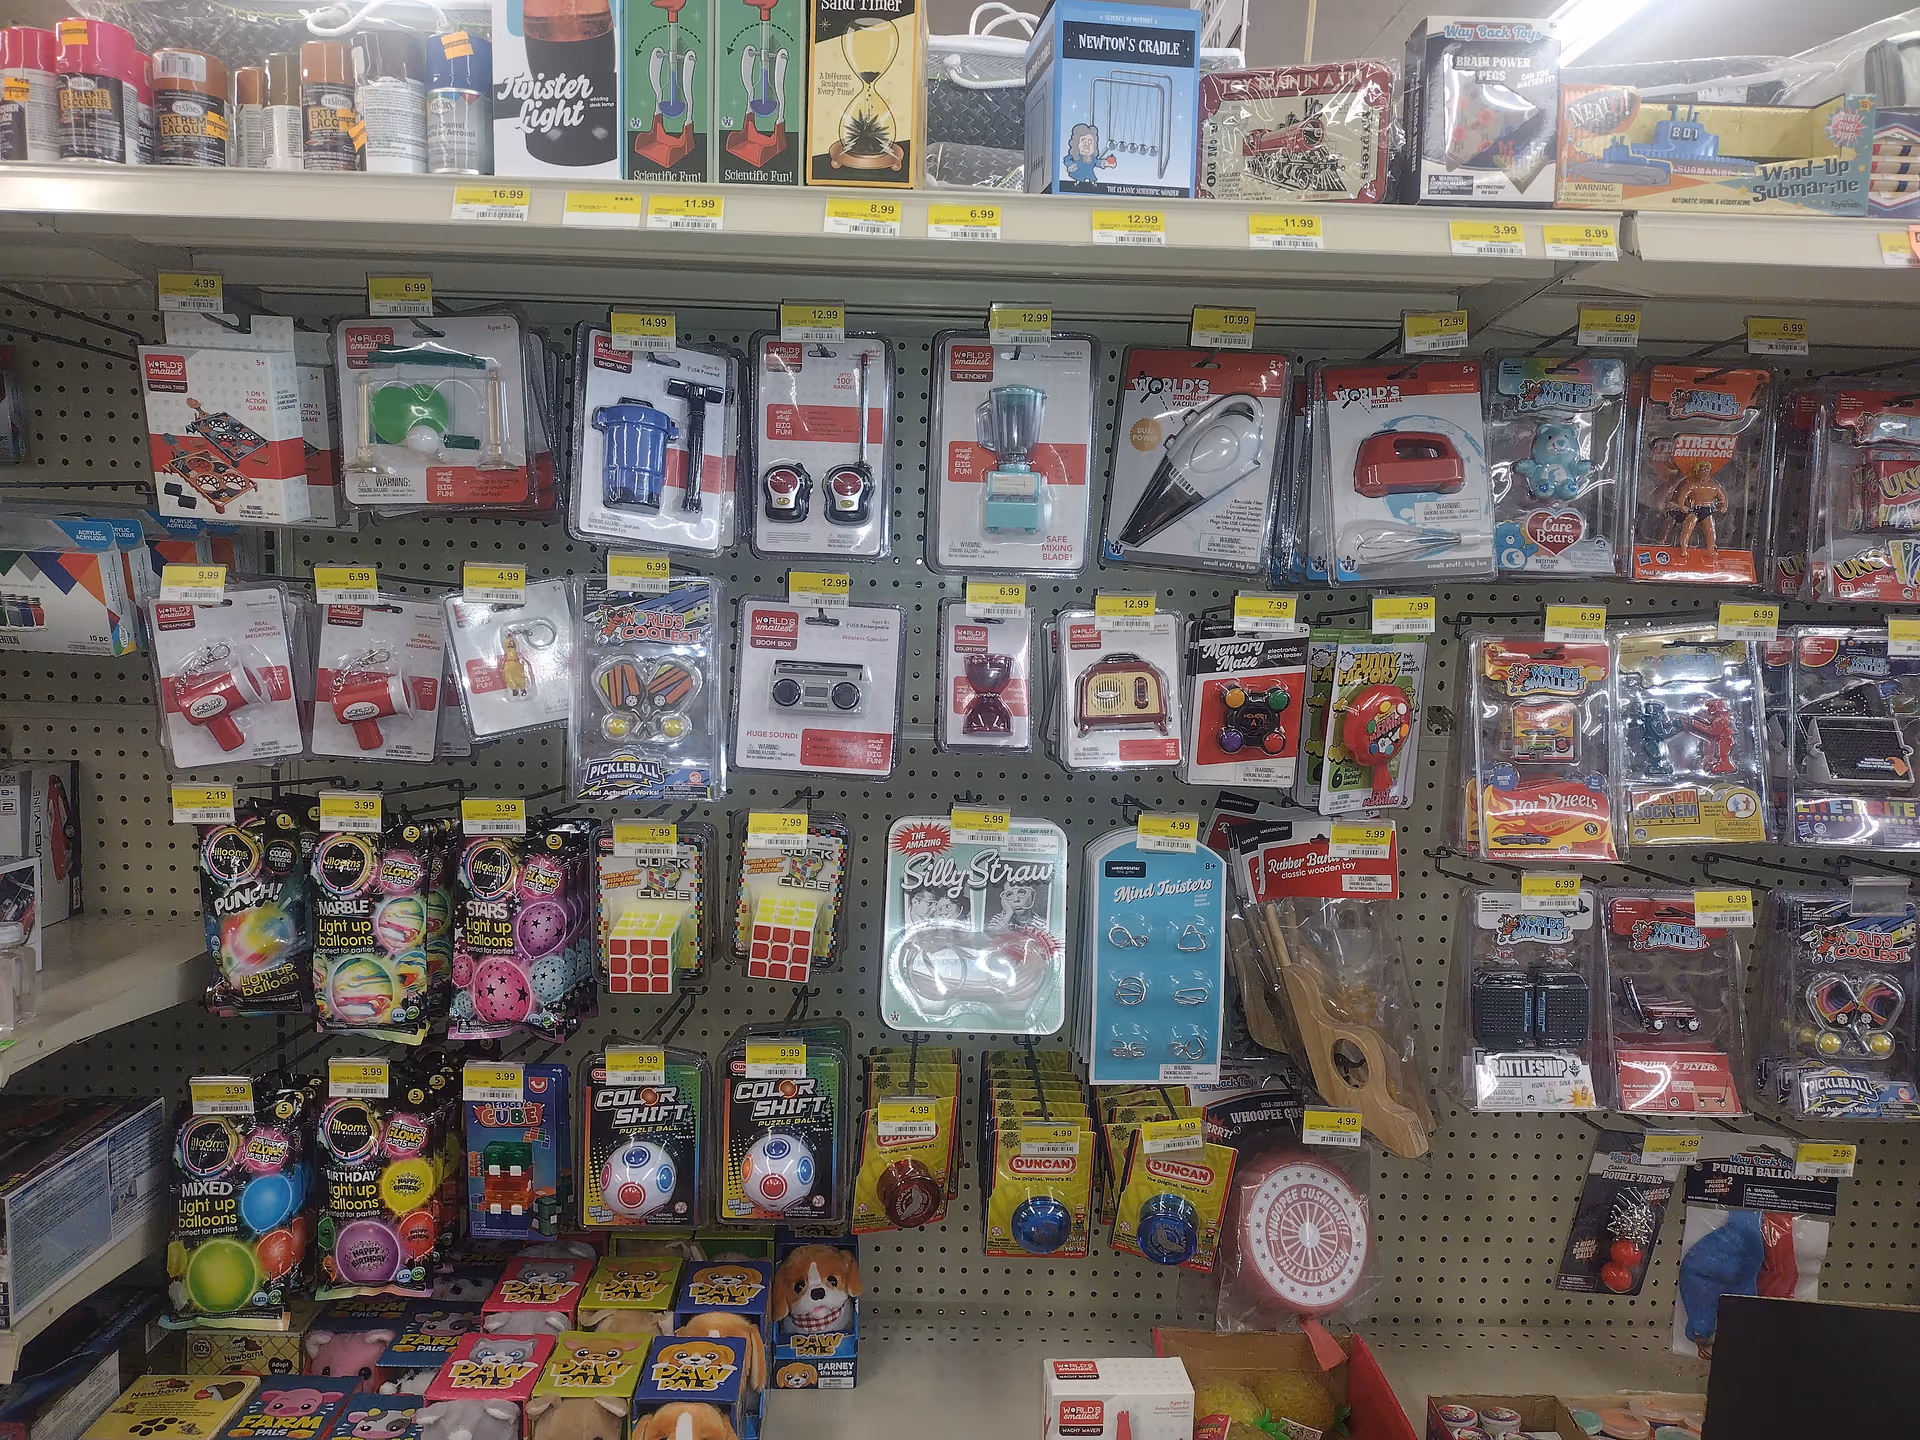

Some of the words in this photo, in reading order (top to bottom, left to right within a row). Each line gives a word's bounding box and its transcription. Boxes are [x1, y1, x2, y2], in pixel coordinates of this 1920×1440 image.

[822, 0, 855, 11] Sand
[860, 0, 902, 11] Timer
[1444, 24, 1475, 40] Way
[1477, 26, 1508, 39] Back
[1513, 24, 1542, 40] Toys
[1079, 34, 1135, 54] NEWTON'S
[1138, 38, 1180, 56] CRADLE
[1457, 56, 1491, 67] BRAIN
[1493, 57, 1530, 68] POWER
[828, 72, 852, 81] Different
[1479, 70, 1506, 81] PEGS
[497, 72, 592, 102] Twister
[820, 81, 849, 90] Sculpture
[62, 91, 106, 101] EXTREME
[818, 88, 835, 97] Every
[837, 87, 854, 96] Time!
[62, 99, 108, 110] LACQUER
[515, 101, 583, 135] Light
[1672, 127, 1699, 140] 801
[725, 170, 770, 182] Scientific
[771, 170, 792, 182] Fun!
[1760, 159, 1849, 183] Wind-Up
[1107, 186, 1117, 194] THE
[1118, 187, 1136, 195] CLASSIC
[1574, 183, 1616, 192] WARNING:
[1752, 180, 1859, 203] Submarine
[491, 188, 524, 202] 16.99
[683, 198, 716, 211] 11.99
[869, 203, 896, 216] 8.99
[970, 209, 995, 222] 6.99
[1126, 214, 1159, 226] 12.99
[1283, 217, 1314, 230] 11.99
[1493, 225, 1518, 236] 3.99
[1584, 229, 1609, 240] 8.99
[193, 278, 216, 290] 4.99
[403, 282, 427, 294] 6.99
[811, 309, 839, 321] 12.99
[1021, 312, 1049, 325] 12.99
[1223, 314, 1250, 327] 10.99
[1614, 313, 1637, 325] 6.99
[639, 316, 668, 329] 14.99
[1438, 318, 1465, 330] 12.99
[1782, 323, 1805, 334] 6.99
[349, 335, 391, 348] WORLD'S
[954, 351, 991, 361] WORLD'S
[955, 358, 990, 366] smallest
[148, 360, 184, 371] WORLD'S
[1270, 360, 1282, 370] 5+
[1463, 366, 1474, 374] 5+
[1132, 378, 1210, 396] WORLD'S
[1172, 393, 1209, 401] smallest
[1334, 385, 1400, 402] WORLD'S
[1370, 396, 1402, 404] smallest
[775, 422, 792, 430] BIG
[1677, 437, 1736, 450] STRETCH
[1674, 448, 1733, 459] ARMSTRONG
[376, 477, 411, 488] WARNING:
[1542, 520, 1573, 534] Care
[1537, 532, 1575, 545] Bears
[1040, 544, 1073, 553] MIXING
[1041, 552, 1073, 561] BLADE!
[646, 562, 668, 574] 6.99
[1465, 561, 1475, 569] big
[1835, 548, 1889, 579] UNO
[197, 570, 220, 582] 9.99
[348, 572, 371, 583] 6.99
[497, 571, 520, 583] 4.99
[820, 577, 849, 589] 12.99
[999, 586, 1021, 599] 6.99
[1122, 598, 1150, 611] 12.99
[1267, 599, 1289, 612] 7.99
[1407, 600, 1430, 613] 7.99
[158, 607, 191, 615] WORLD'S
[1580, 611, 1602, 623] 6.99
[1752, 609, 1774, 621] 6.99
[622, 612, 684, 630] WORLD'S
[755, 617, 796, 626] WORLD'S
[756, 623, 795, 632] smallest
[623, 625, 700, 644] COOLEST
[1203, 641, 1263, 663] Memory
[1217, 656, 1259, 672] Maze
[1355, 651, 1399, 668] FUNNY
[1338, 665, 1398, 686] FACTORY
[591, 764, 662, 782] PICKLEBALL
[205, 790, 228, 802] 2.19
[604, 789, 633, 798] Actually
[634, 789, 659, 798] Works!
[353, 800, 376, 812] 3.99
[495, 803, 517, 815] 3.99
[1508, 797, 1540, 816] HOT
[1539, 792, 1598, 811] WHEELS
[780, 818, 803, 830] 7.99
[983, 814, 1005, 826] 5.99
[1170, 822, 1191, 834] 4.99
[649, 829, 671, 840] 7.99
[911, 831, 926, 840] THE
[1364, 829, 1386, 841] 5.99
[906, 839, 942, 850] AMAZING
[1205, 863, 1217, 871] 8+
[1281, 870, 1306, 881] classic
[1307, 864, 1340, 876] wooden
[1342, 860, 1356, 872] toy
[901, 852, 968, 899] Silly
[966, 850, 1054, 890] Straw
[779, 877, 830, 891] CUBE
[1553, 879, 1575, 890] 6.99
[1114, 885, 1154, 903] Mind
[1158, 878, 1212, 895] Twisters
[214, 883, 283, 916] PUNCH!
[1727, 894, 1748, 904] 6.99
[318, 901, 369, 915] MARBLE
[466, 901, 507, 918] STARS
[319, 919, 349, 936] Light
[352, 922, 371, 936] up
[467, 918, 491, 934] Light
[493, 921, 511, 936] up
[319, 934, 373, 946] balloons
[466, 934, 513, 947] balloons
[1838, 931, 1892, 947] WORLD'S
[1835, 944, 1907, 962] COOLEST
[242, 971, 300, 997] balloon
[779, 1048, 801, 1058] 9.99
[637, 1055, 659, 1067] 9.99
[361, 1067, 383, 1079] 3.99
[1491, 1060, 1566, 1077] BATTLESHIP
[494, 1070, 516, 1083] 3.99
[224, 1085, 247, 1096] 3.99
[734, 1078, 817, 1102] COLOR
[1810, 1078, 1870, 1094] PICKLEBALL
[598, 1088, 678, 1108] COLOR
[753, 1096, 828, 1120] SHIFT
[908, 1104, 930, 1115] 4.99
[482, 1107, 540, 1125] CUBE
[615, 1105, 687, 1127] SHIFT
[1336, 1116, 1358, 1127] 4.99
[758, 1119, 792, 1127] PUZZLE
[1175, 1120, 1197, 1132] 4.99
[619, 1126, 653, 1134] PUZZLE
[656, 1125, 680, 1133] BALL
[1051, 1129, 1072, 1138] 4.99
[1679, 1139, 1700, 1148] 4.99
[1832, 1148, 1853, 1159] 2.99
[1015, 1159, 1071, 1170] DUNCAN
[1712, 1162, 1754, 1177] PUNCH
[1153, 1161, 1209, 1182] DUNCAN
[1602, 1170, 1635, 1181] DOUBLE
[1637, 1174, 1665, 1186] JACKS
[182, 1182, 233, 1197] MIXED
[355, 1186, 376, 1200] up
[179, 1200, 210, 1217] Light
[213, 1199, 235, 1214] up
[179, 1213, 237, 1229] balloons
[796, 1345, 836, 1357] PALS
[818, 1362, 854, 1370] BARNEY
[831, 1370, 853, 1378] beagle
[452, 1376, 513, 1388] PALS
[556, 1375, 614, 1387] PALS
[658, 1378, 719, 1391] PALS
[1063, 1406, 1101, 1414] WORLD'S
[1064, 1412, 1100, 1420] smallest
[256, 1428, 287, 1437] PALS
